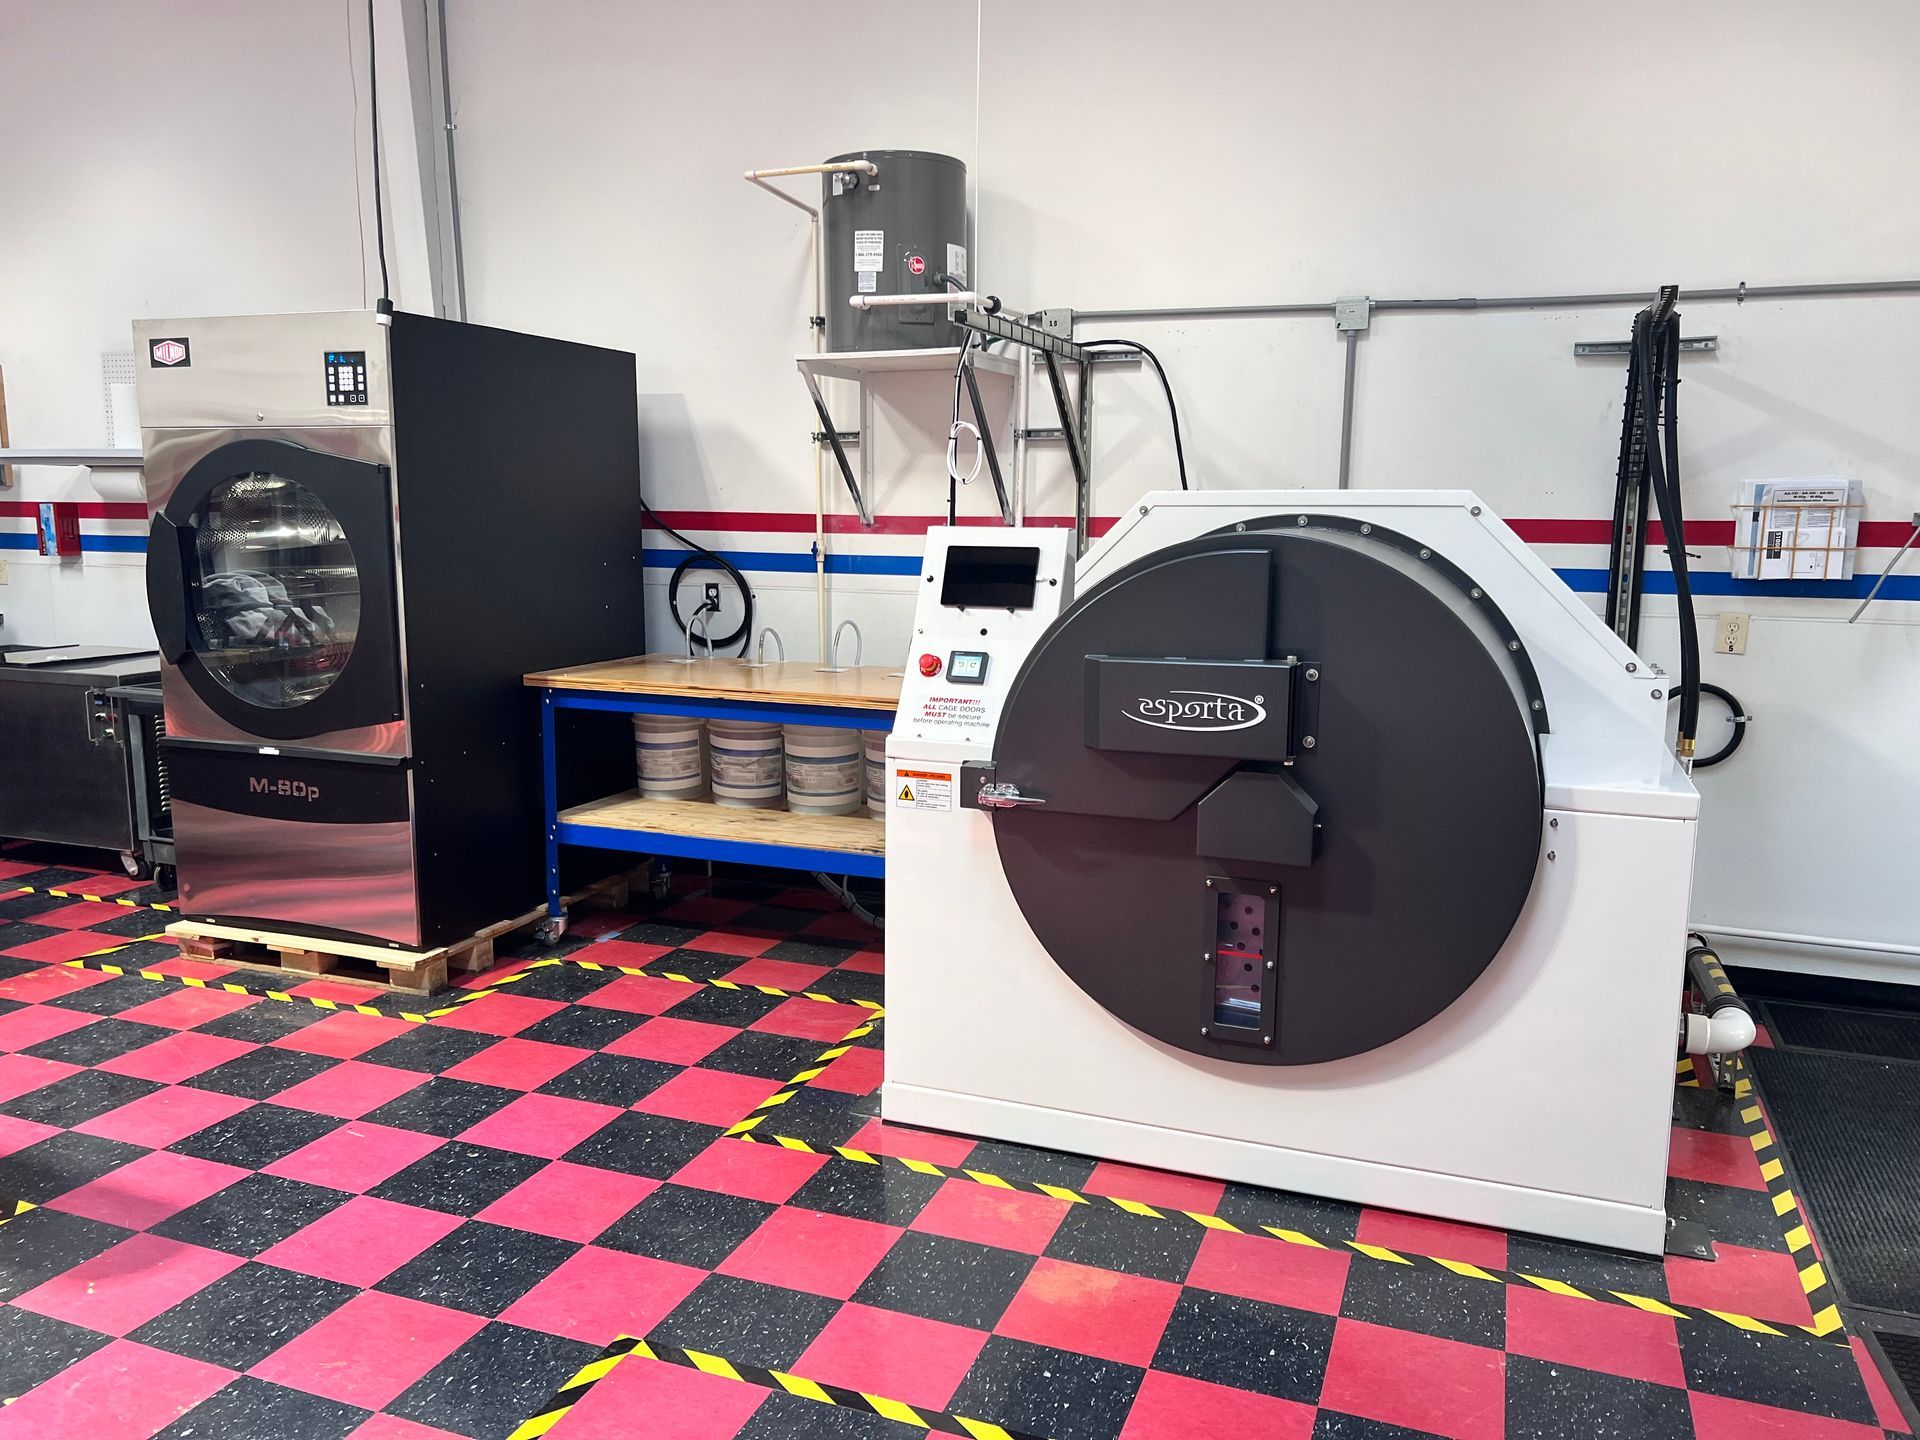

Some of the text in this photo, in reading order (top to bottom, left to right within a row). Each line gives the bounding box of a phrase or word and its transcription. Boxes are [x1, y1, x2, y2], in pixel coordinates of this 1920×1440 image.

[928, 697, 981, 705] IMPORTANT!!!
[1138, 698, 1245, 724] esporta
[934, 719, 962, 727] operating
